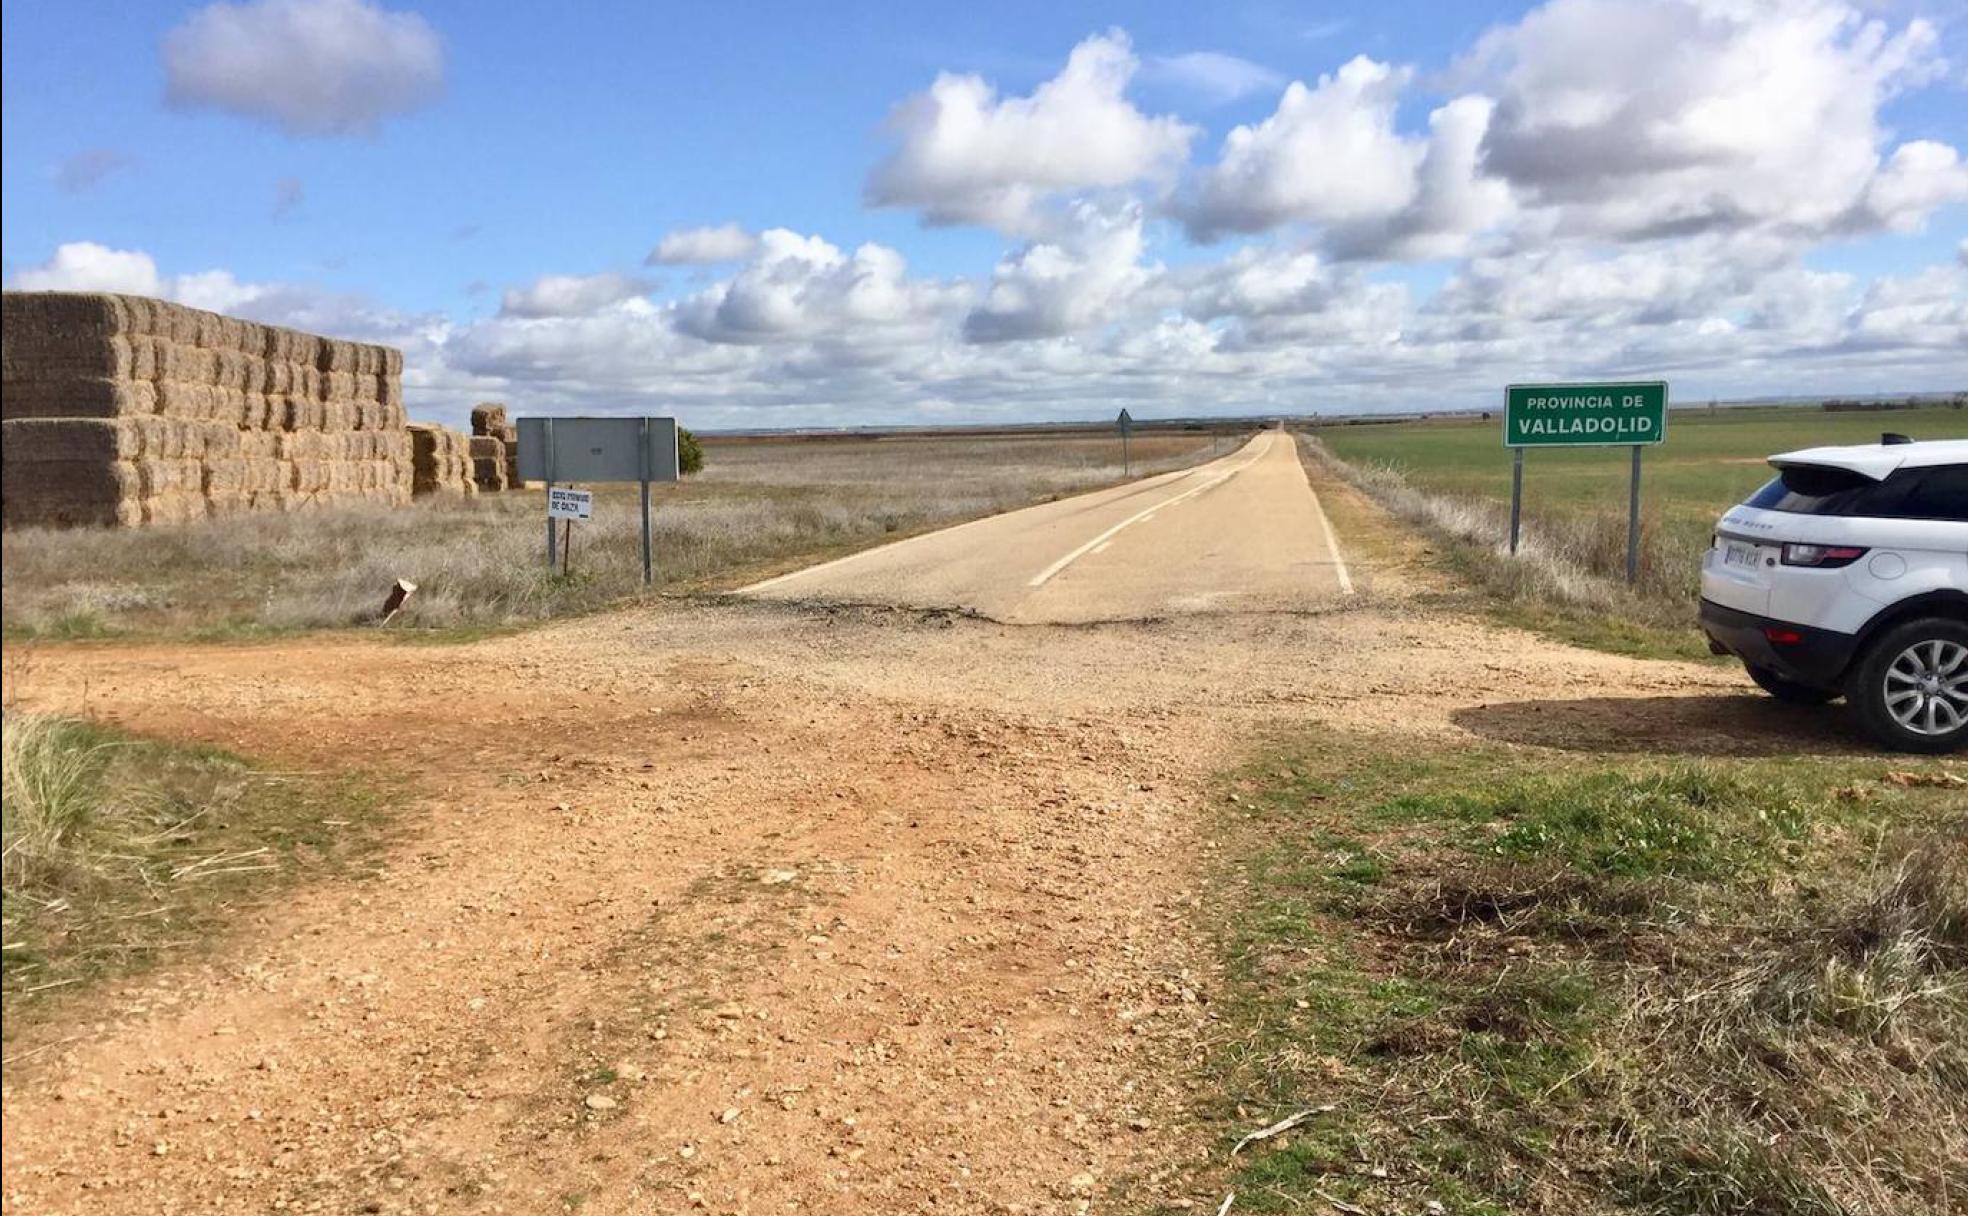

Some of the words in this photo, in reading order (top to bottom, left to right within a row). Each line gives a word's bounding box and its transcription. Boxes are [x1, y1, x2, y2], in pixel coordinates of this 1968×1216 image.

[1527, 396, 1613, 410] PROVINCIA
[1622, 395, 1644, 408] DE
[1519, 417, 1652, 434] VALLADOLID
